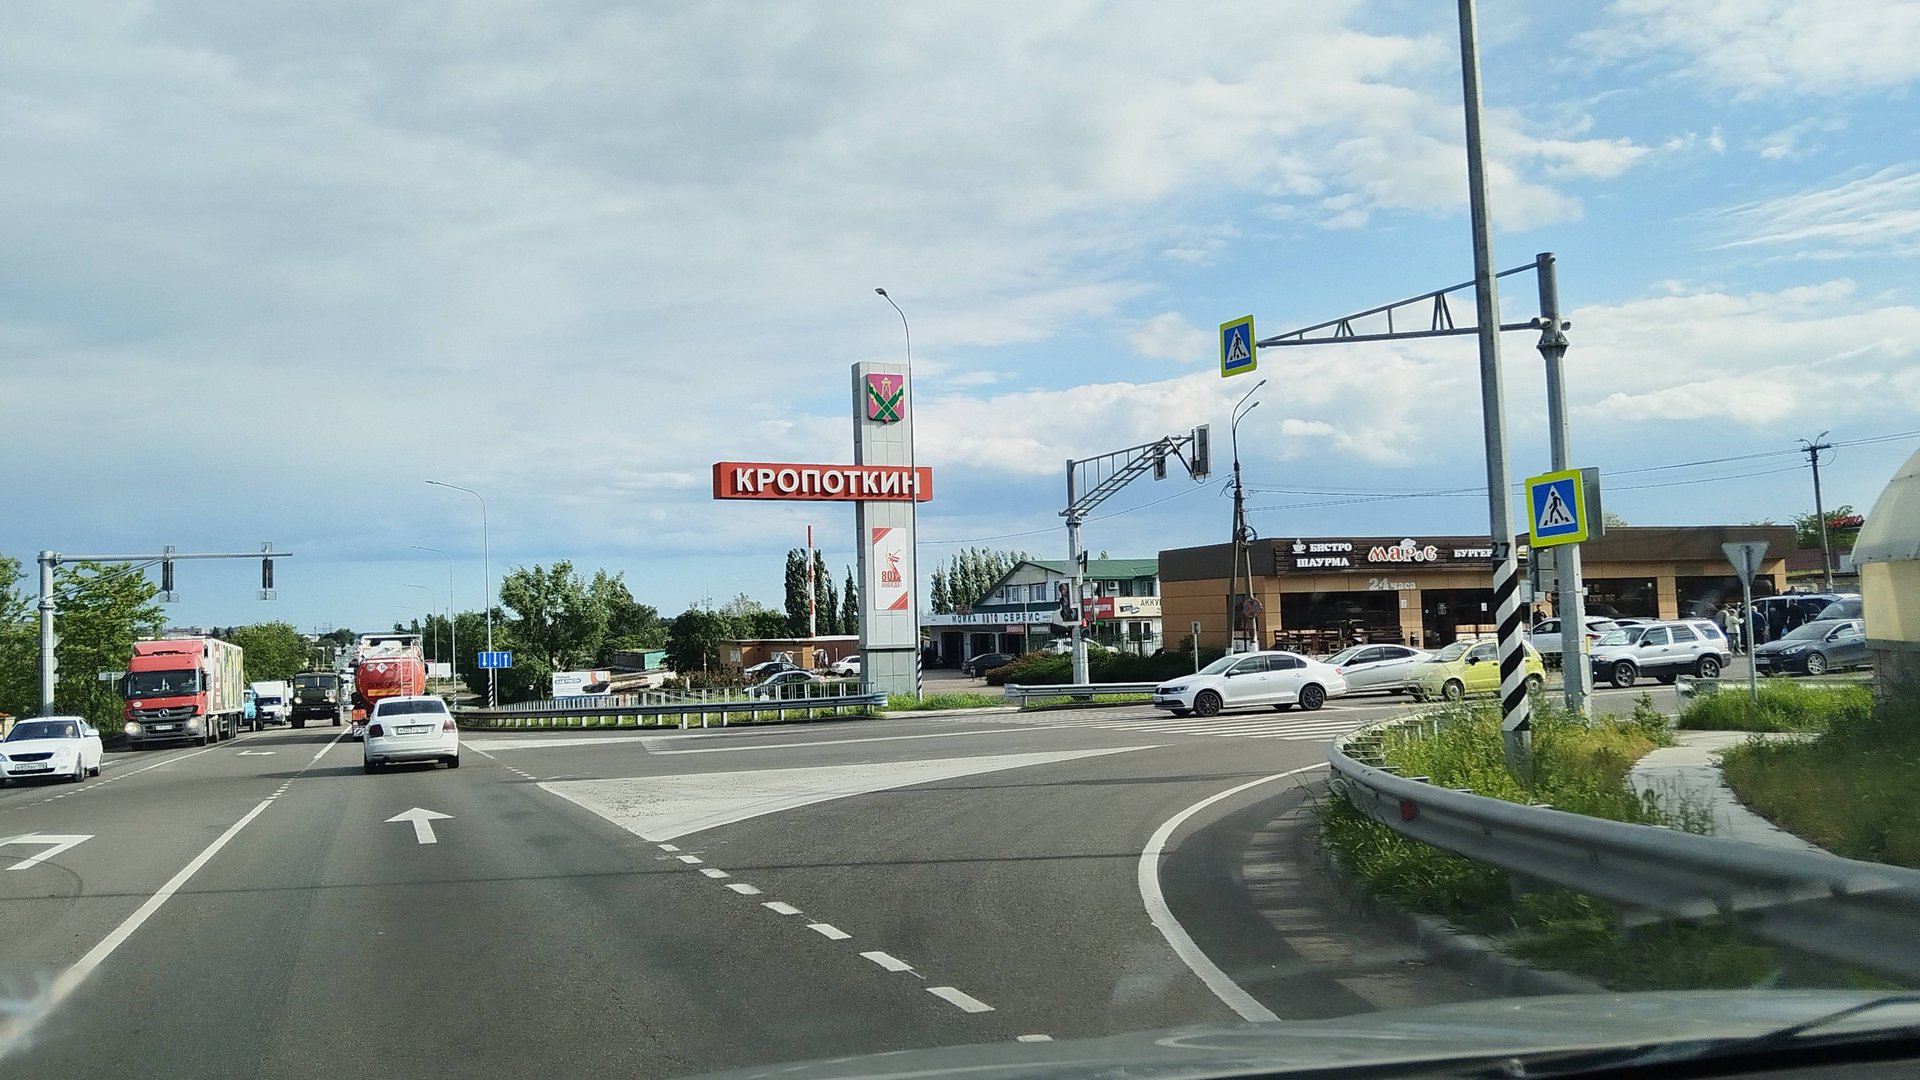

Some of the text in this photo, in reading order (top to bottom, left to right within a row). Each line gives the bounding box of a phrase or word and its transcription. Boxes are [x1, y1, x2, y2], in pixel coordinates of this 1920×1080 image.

[736, 467, 920, 494] КРОПОТКИН
[1309, 543, 1352, 552] БИСТРО
[1491, 542, 1510, 558] 27
[1296, 558, 1350, 567] ШАУРМА
[881, 571, 893, 582] 80
[1368, 578, 1417, 591] 24 часа
[1003, 612, 1040, 622] СЕРВИС
